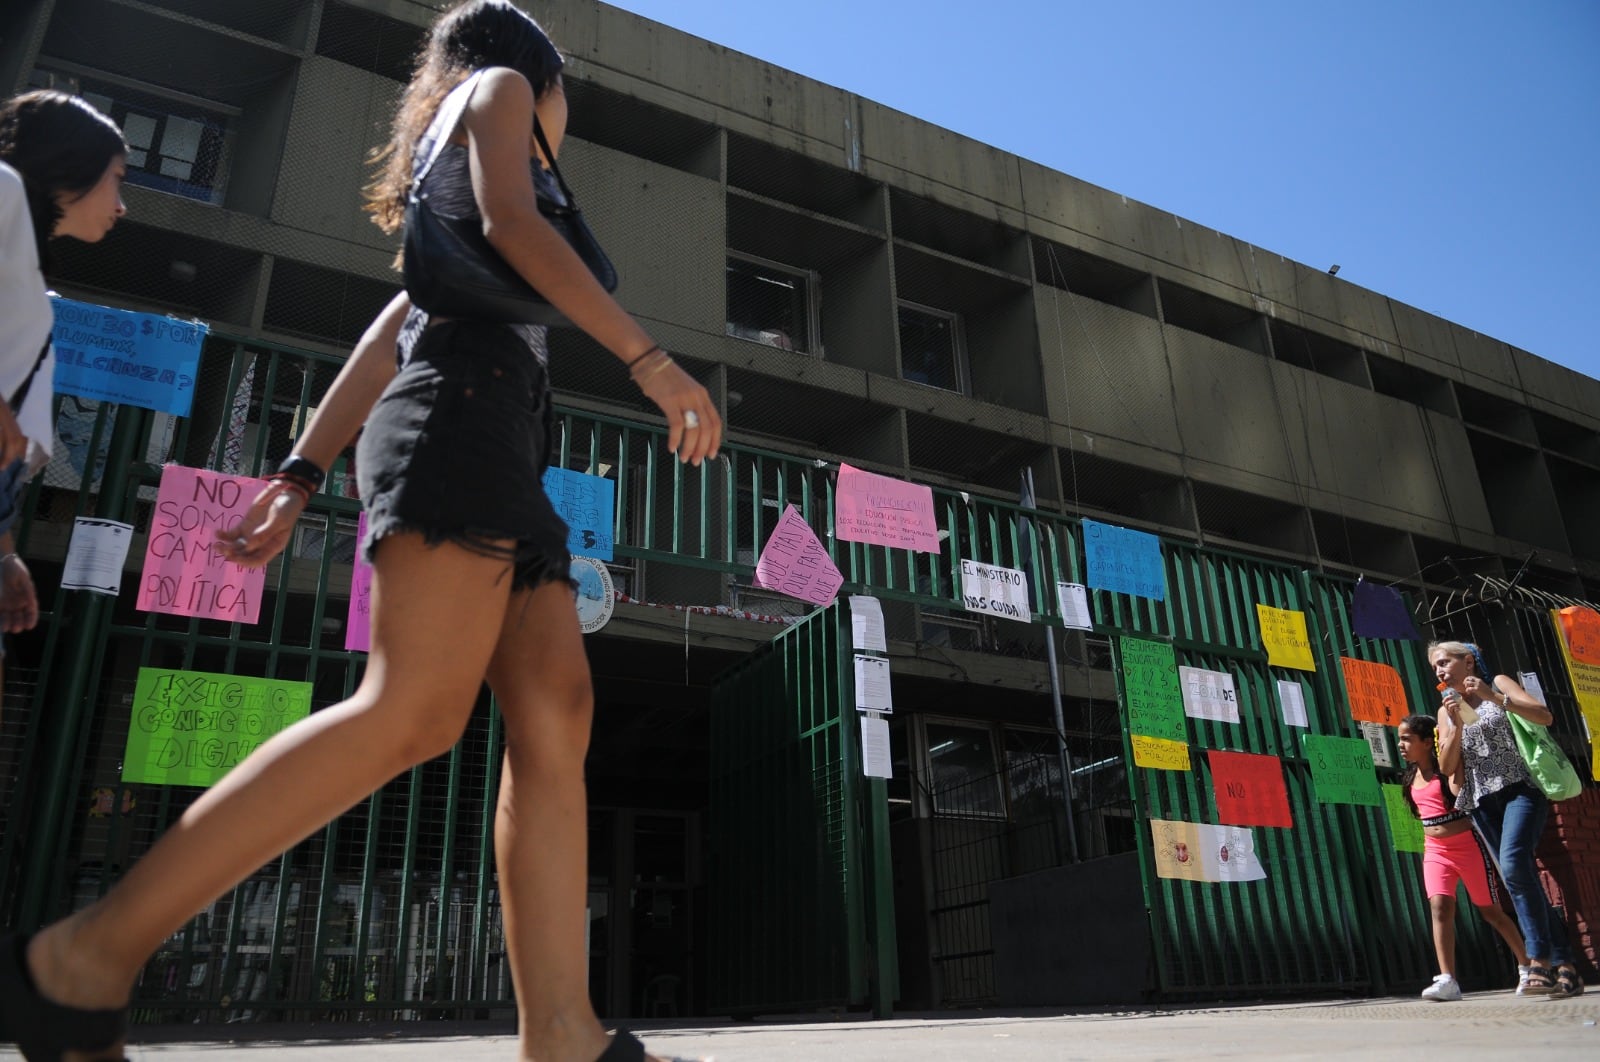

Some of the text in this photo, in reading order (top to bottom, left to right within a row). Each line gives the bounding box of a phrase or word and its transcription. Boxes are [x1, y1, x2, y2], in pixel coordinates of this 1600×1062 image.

[103, 313, 137, 339] 30
[156, 319, 200, 347] POR
[193, 475, 242, 509] NO
[783, 570, 813, 595] QUE
[962, 561, 1021, 586] EL MINISTERIO
[145, 573, 249, 617] POLÍTICA
[809, 577, 836, 603] QUE
[964, 595, 988, 610] NOS
[990, 599, 1020, 617] CUIDA
[1222, 688, 1236, 702] DE
[1317, 752, 1327, 770] 8
[1226, 782, 1247, 799] NO
